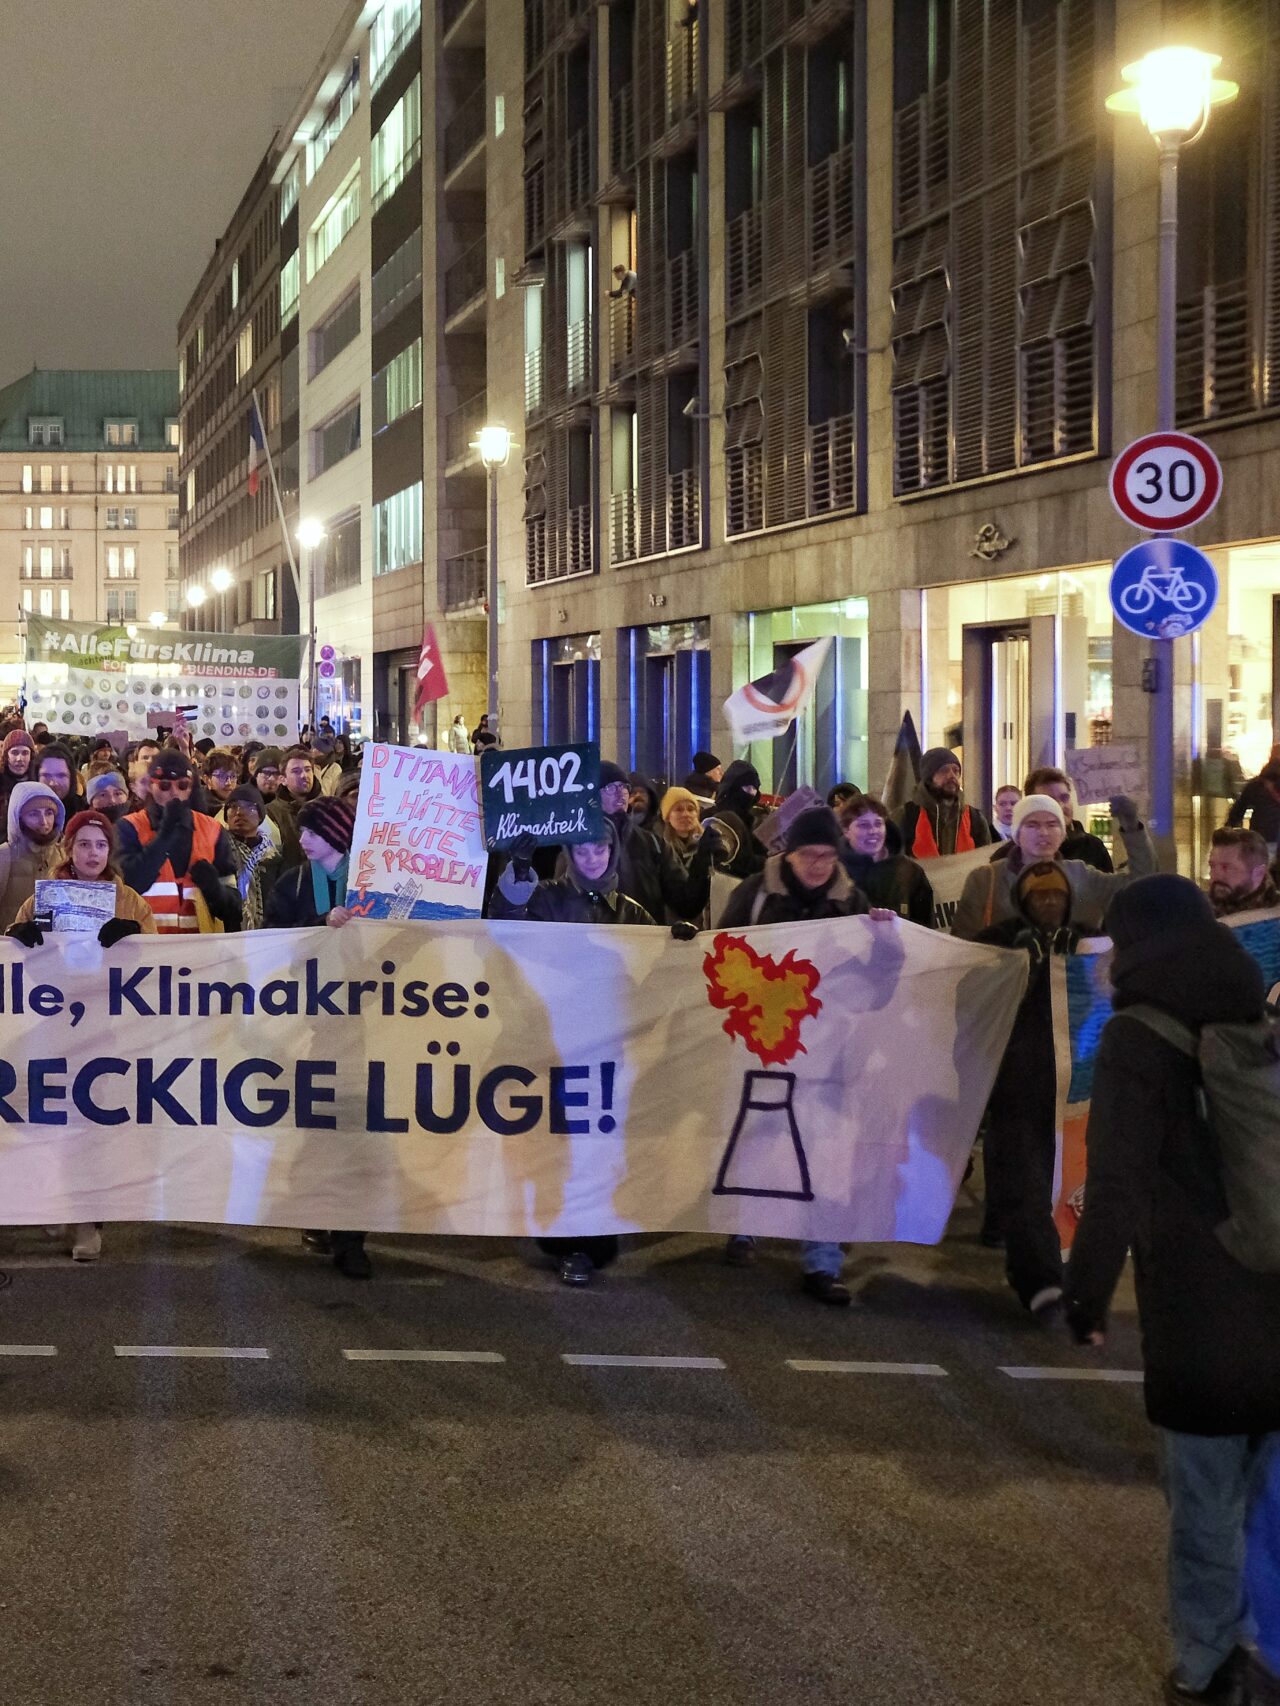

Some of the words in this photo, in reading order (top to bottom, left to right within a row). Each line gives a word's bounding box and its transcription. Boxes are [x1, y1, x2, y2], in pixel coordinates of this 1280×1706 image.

[1136, 459, 1196, 504] 30
[45, 630, 255, 664] #AlleFürsKlima
[488, 751, 595, 804] 14.02.
[496, 807, 588, 841] Klimastreik
[382, 848, 483, 889] PROBLEM
[108, 957, 491, 1019] Klimakrise:
[365, 1040, 616, 1137] LÜGE!
